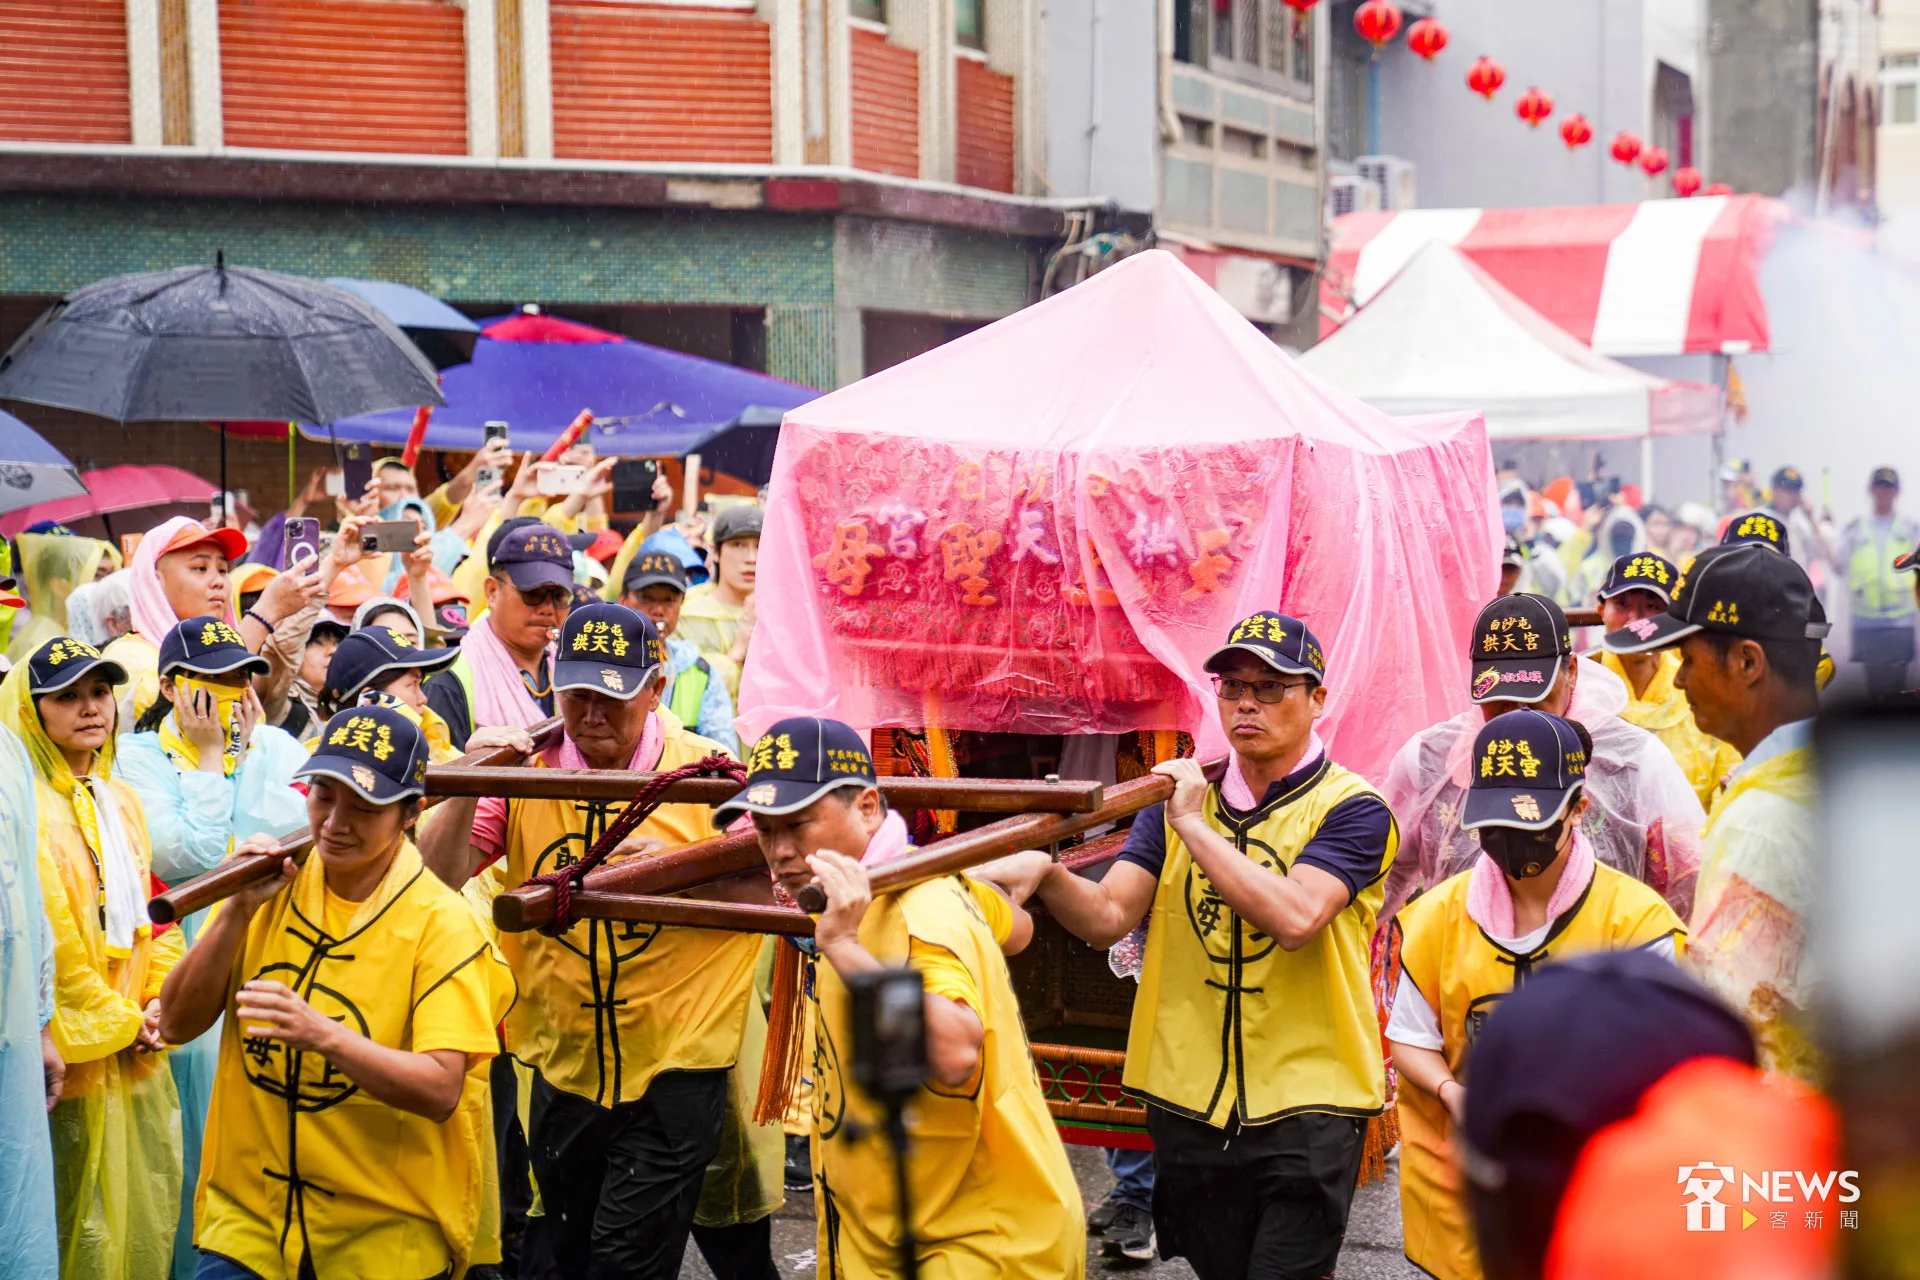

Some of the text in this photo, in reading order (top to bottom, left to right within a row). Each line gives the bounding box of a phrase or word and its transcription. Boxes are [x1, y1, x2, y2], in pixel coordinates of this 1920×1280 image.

[583, 620, 624, 638] 白沙屯
[1490, 616, 1532, 632] 白沙屯
[572, 633, 630, 657] 拱天宮
[1482, 632, 1540, 652] 拱天宮
[328, 726, 395, 761] 拱天宮
[1487, 739, 1533, 757] 白沙屯
[1481, 754, 1541, 778] 拱天宮
